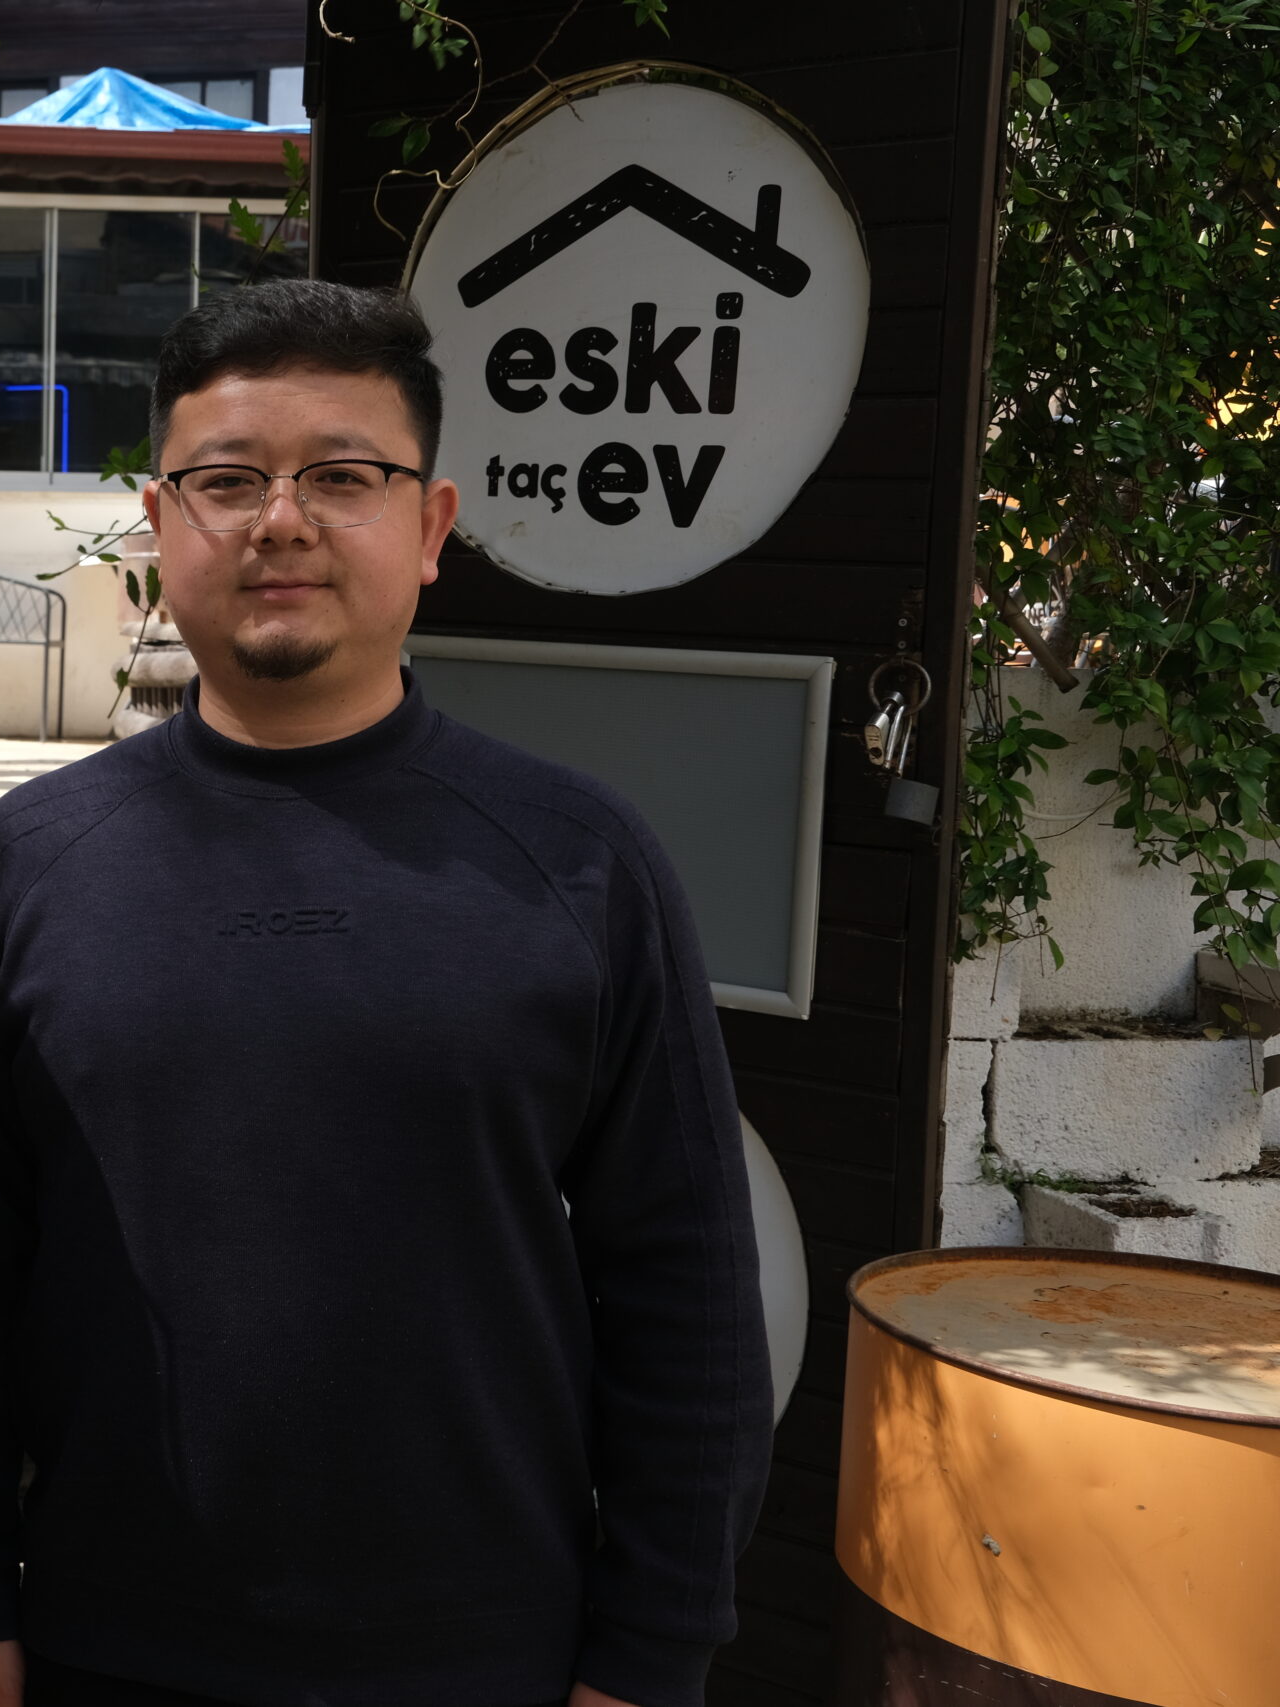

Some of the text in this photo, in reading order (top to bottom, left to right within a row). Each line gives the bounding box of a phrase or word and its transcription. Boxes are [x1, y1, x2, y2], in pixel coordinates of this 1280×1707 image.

[485, 292, 744, 415] eski
[486, 441, 725, 528] taç ev
